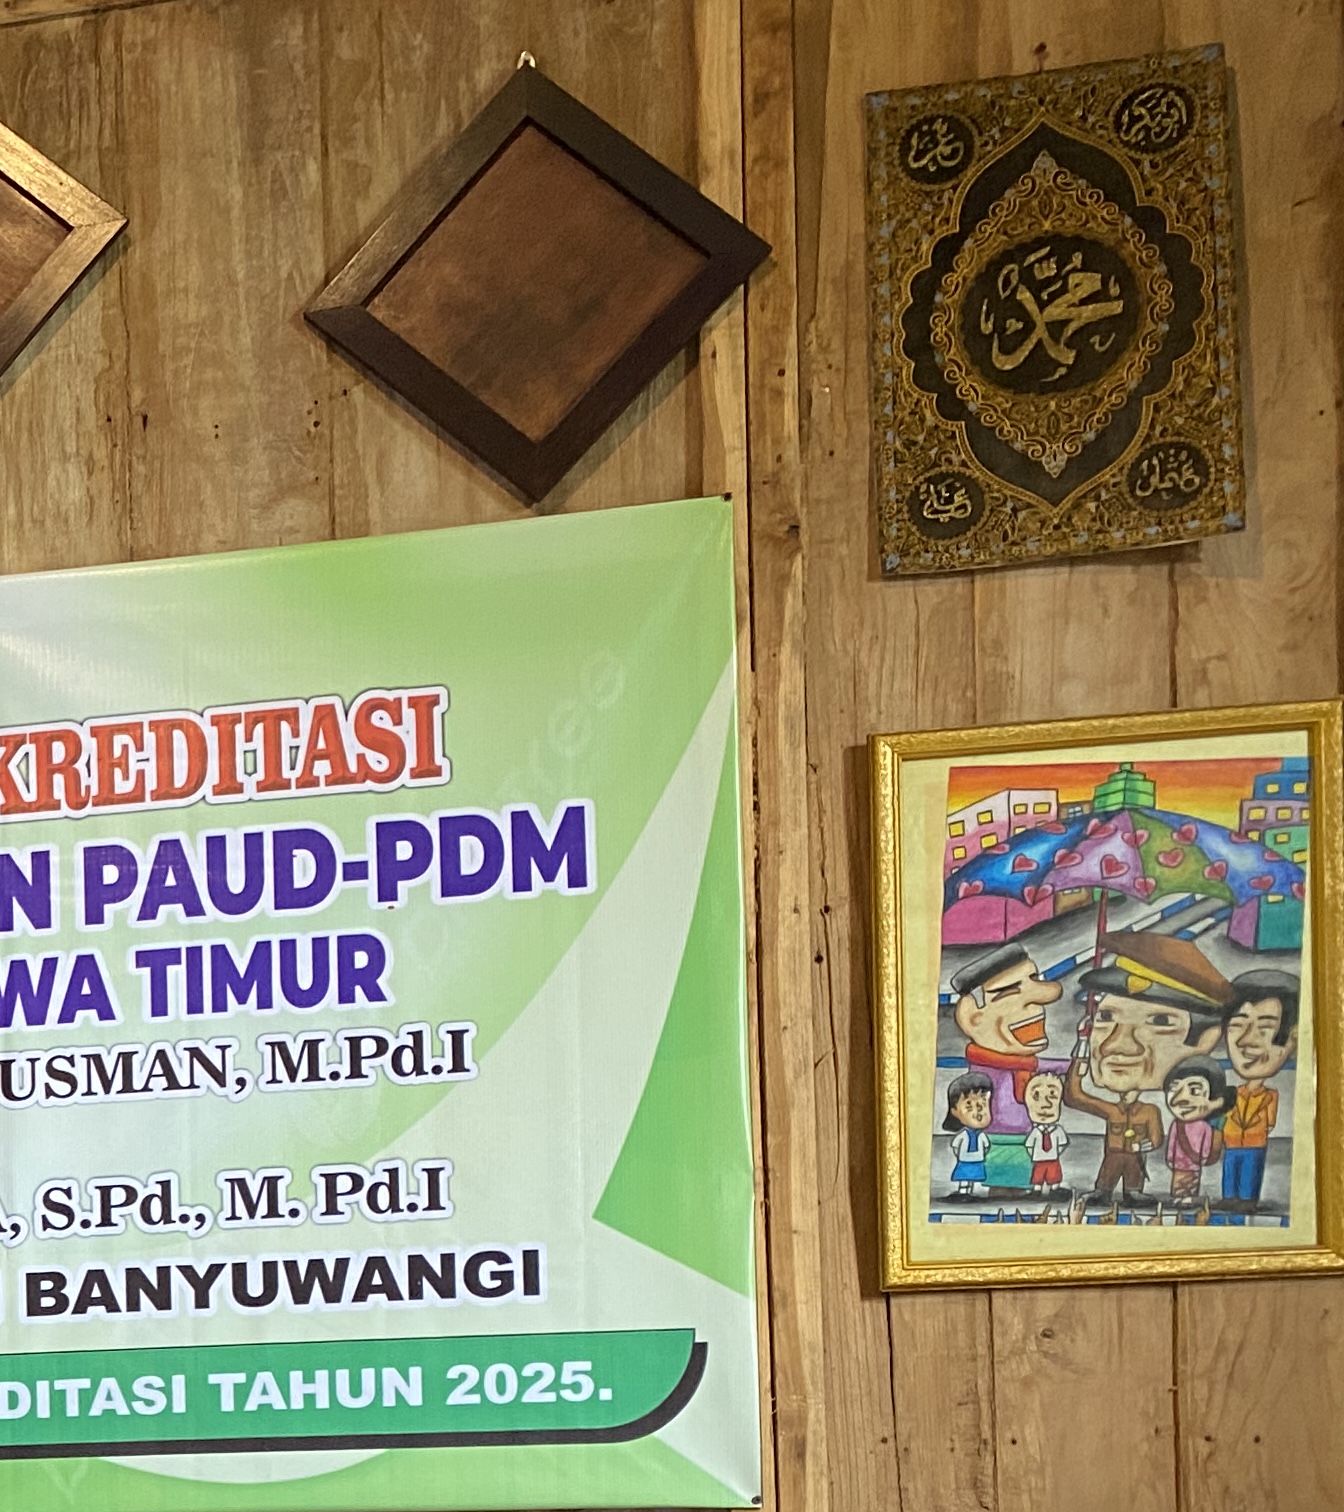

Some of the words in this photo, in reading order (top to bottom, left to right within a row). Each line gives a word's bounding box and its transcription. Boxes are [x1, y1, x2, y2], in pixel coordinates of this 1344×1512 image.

[83, 806, 587, 925] PAUD-PDM
[135, 933, 386, 1017] TIMUR
[265, 1028, 474, 1084] M.Pd.I
[41, 1178, 206, 1232] S.Pd.,
[224, 1174, 300, 1221] M.
[319, 1166, 450, 1216] Pd.I
[25, 1248, 541, 1318] BANYUWANGI
[208, 1366, 423, 1412] TAHUN
[446, 1360, 613, 1405] 2025.
